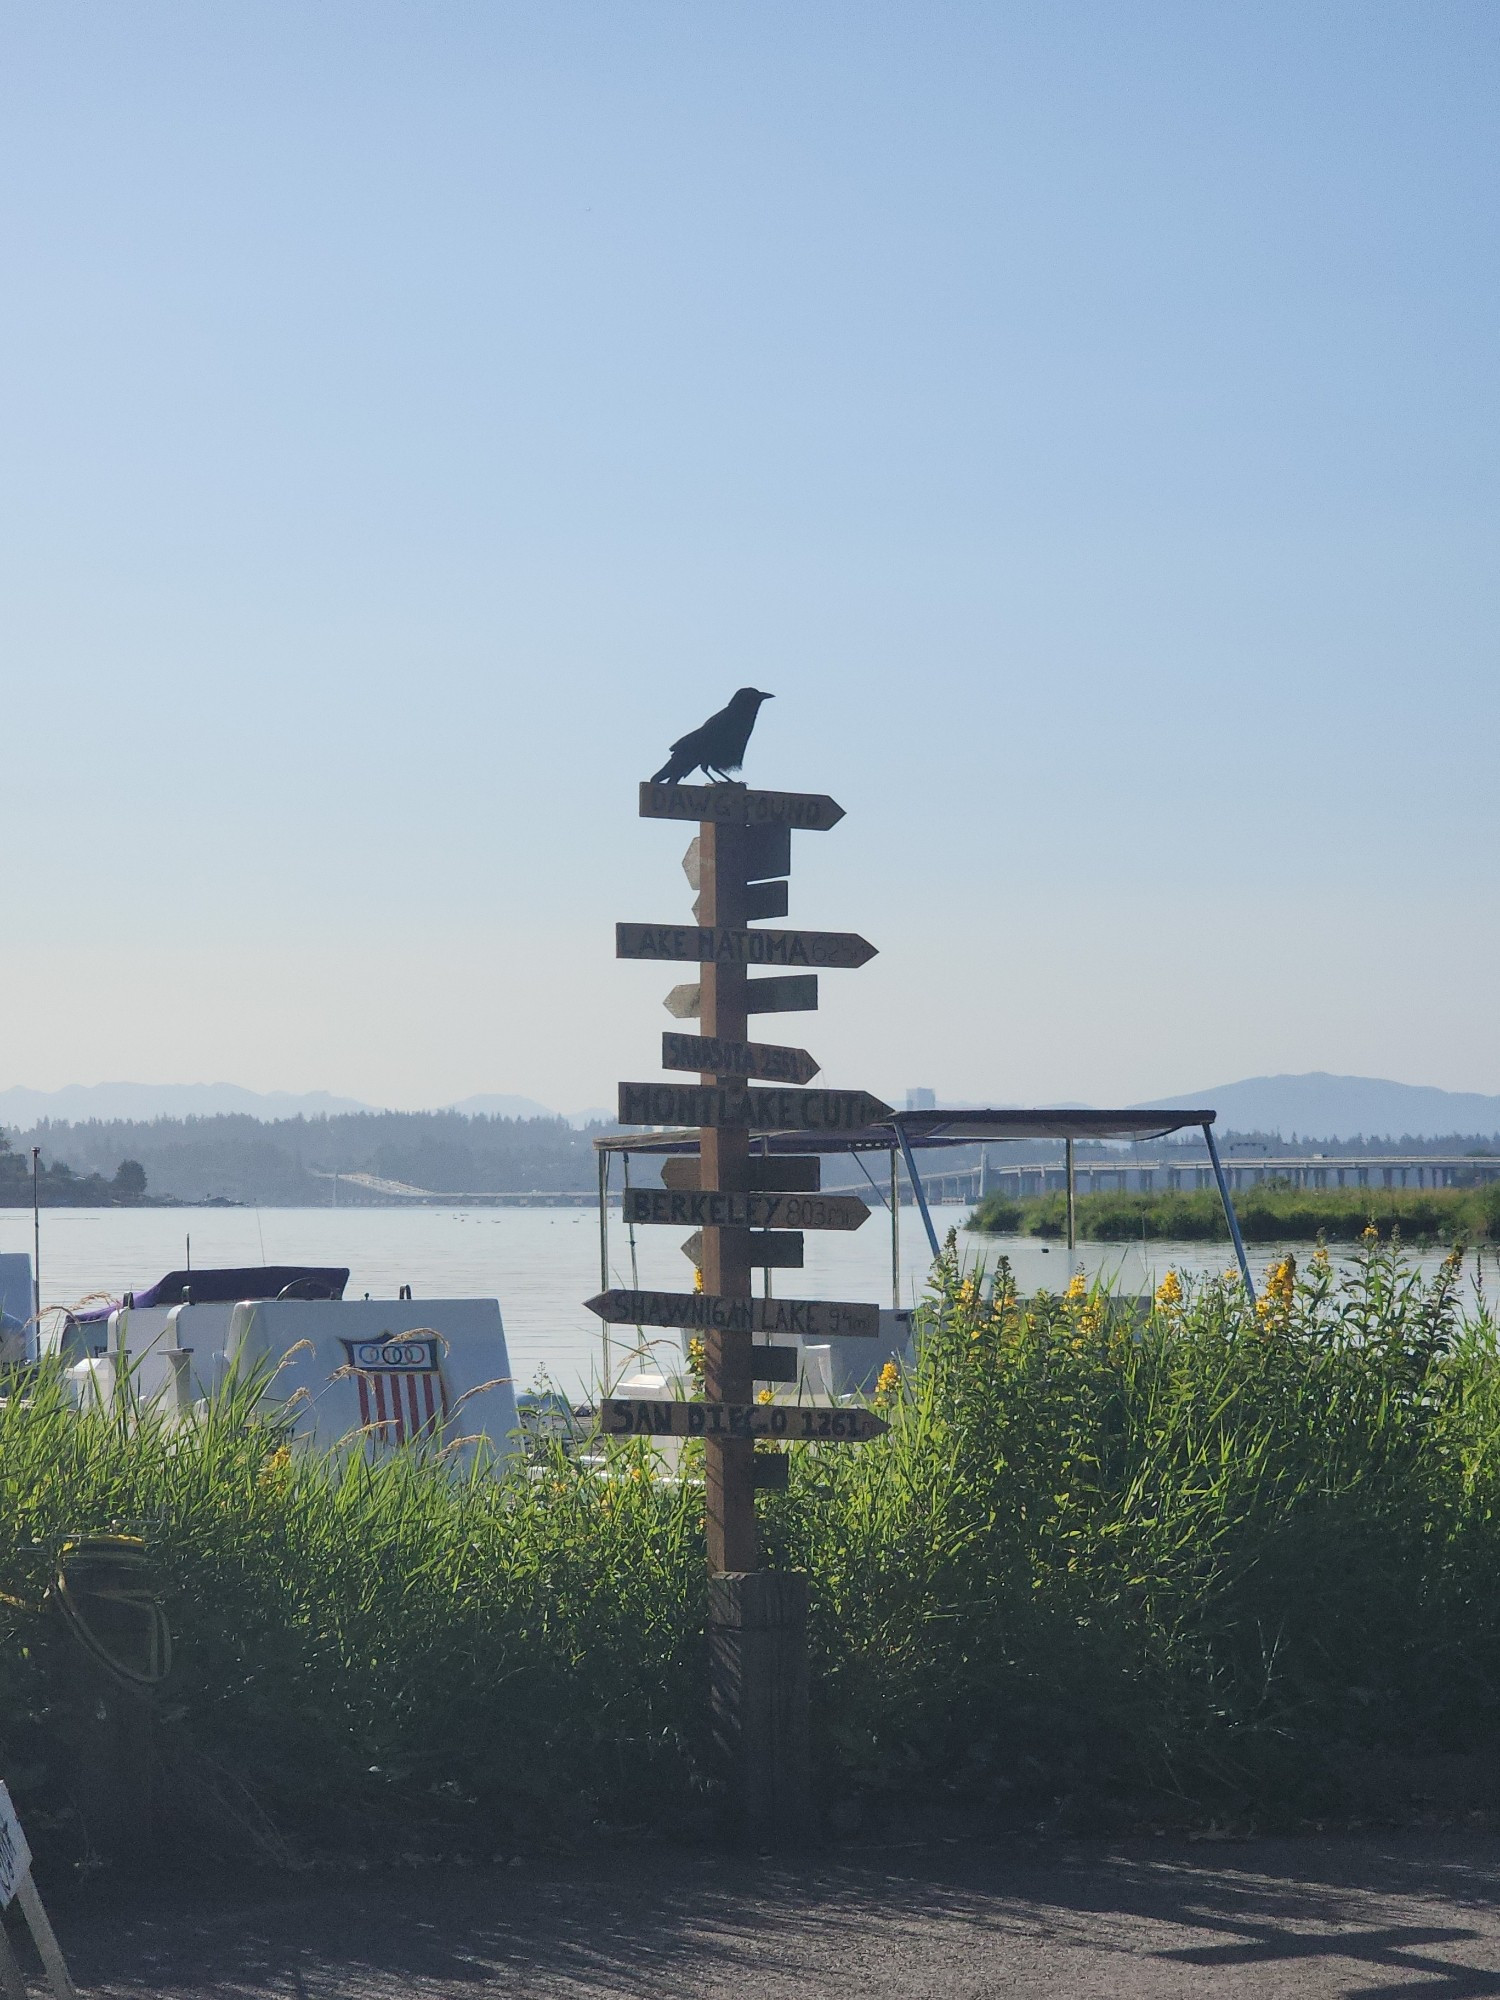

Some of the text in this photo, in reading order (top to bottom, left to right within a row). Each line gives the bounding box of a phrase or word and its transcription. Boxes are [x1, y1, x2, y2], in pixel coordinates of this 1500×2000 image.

[651, 788, 821, 825] DAWG POUND
[619, 927, 687, 958] LAKE
[698, 930, 809, 964] NATOMA
[625, 1086, 795, 1127] MONTLAKE
[801, 1092, 860, 1129] CUT
[633, 1193, 782, 1226] BERKELEY
[614, 1292, 753, 1329] SHAWNIGAN
[761, 1299, 820, 1334] LAKE
[610, 1400, 672, 1435] SAN
[688, 1405, 787, 1436] DIEGO
